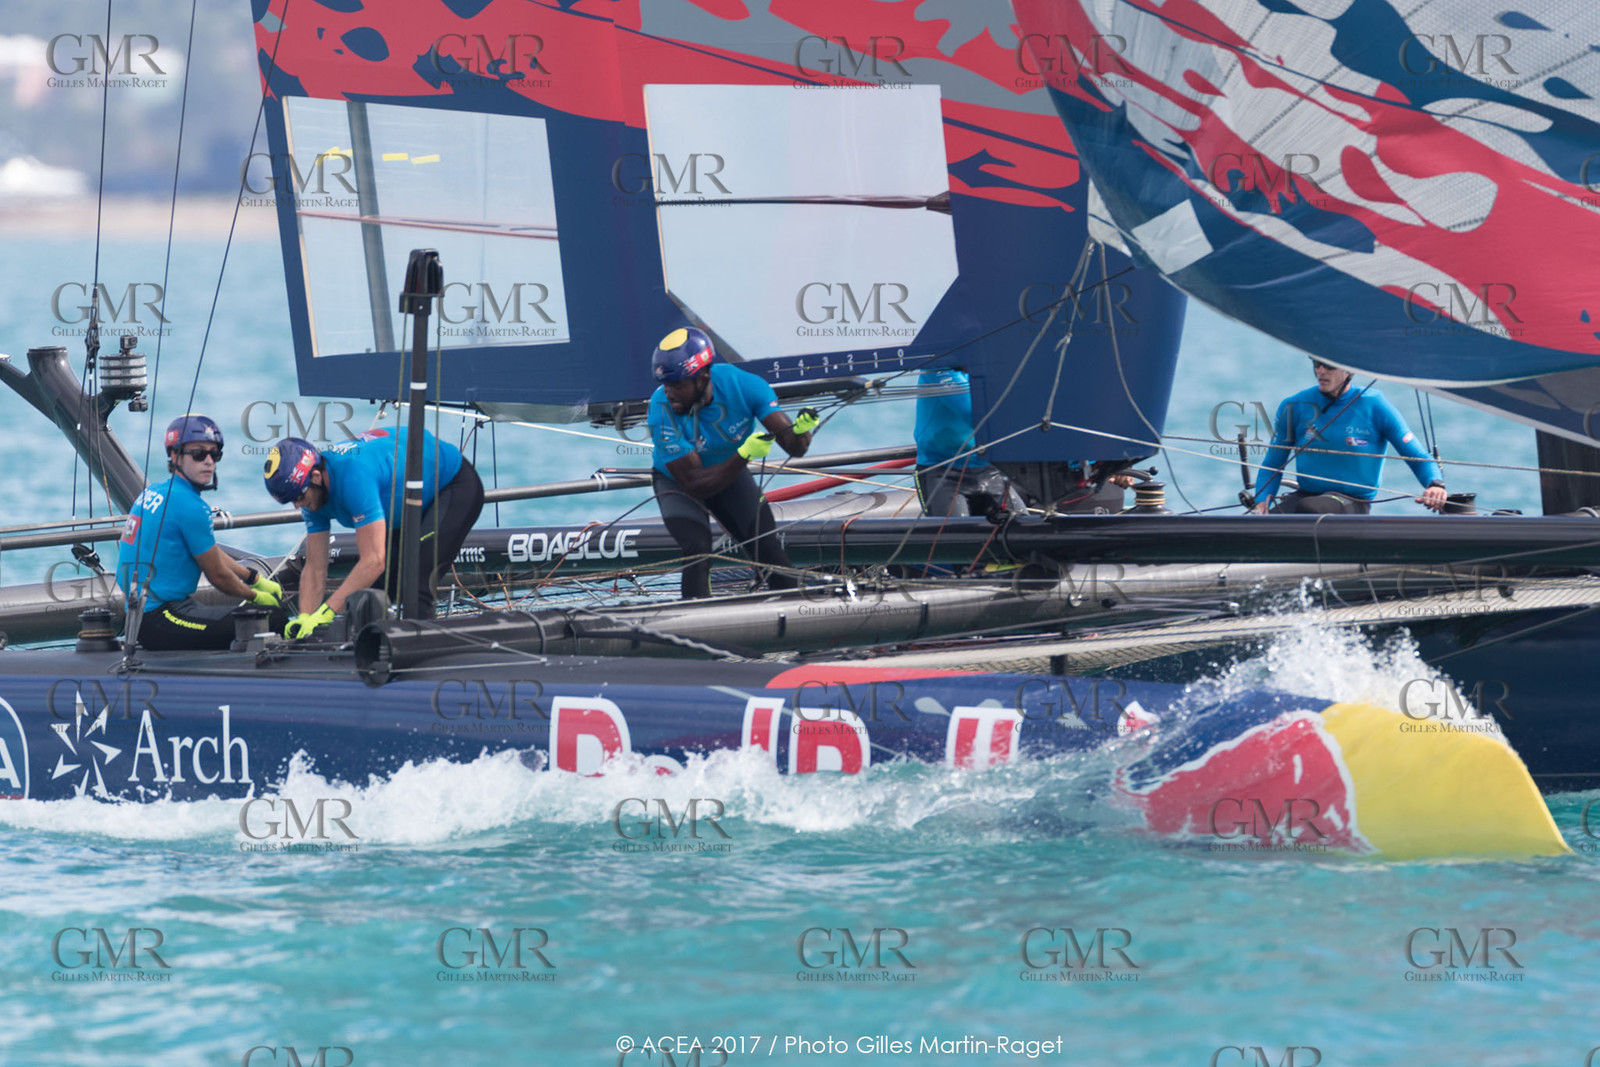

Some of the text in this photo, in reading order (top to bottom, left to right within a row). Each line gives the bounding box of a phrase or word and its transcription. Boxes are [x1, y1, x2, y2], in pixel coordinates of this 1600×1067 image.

[773, 349, 904, 371] 5 4 3 2 1 0
[128, 705, 253, 785] Arch
